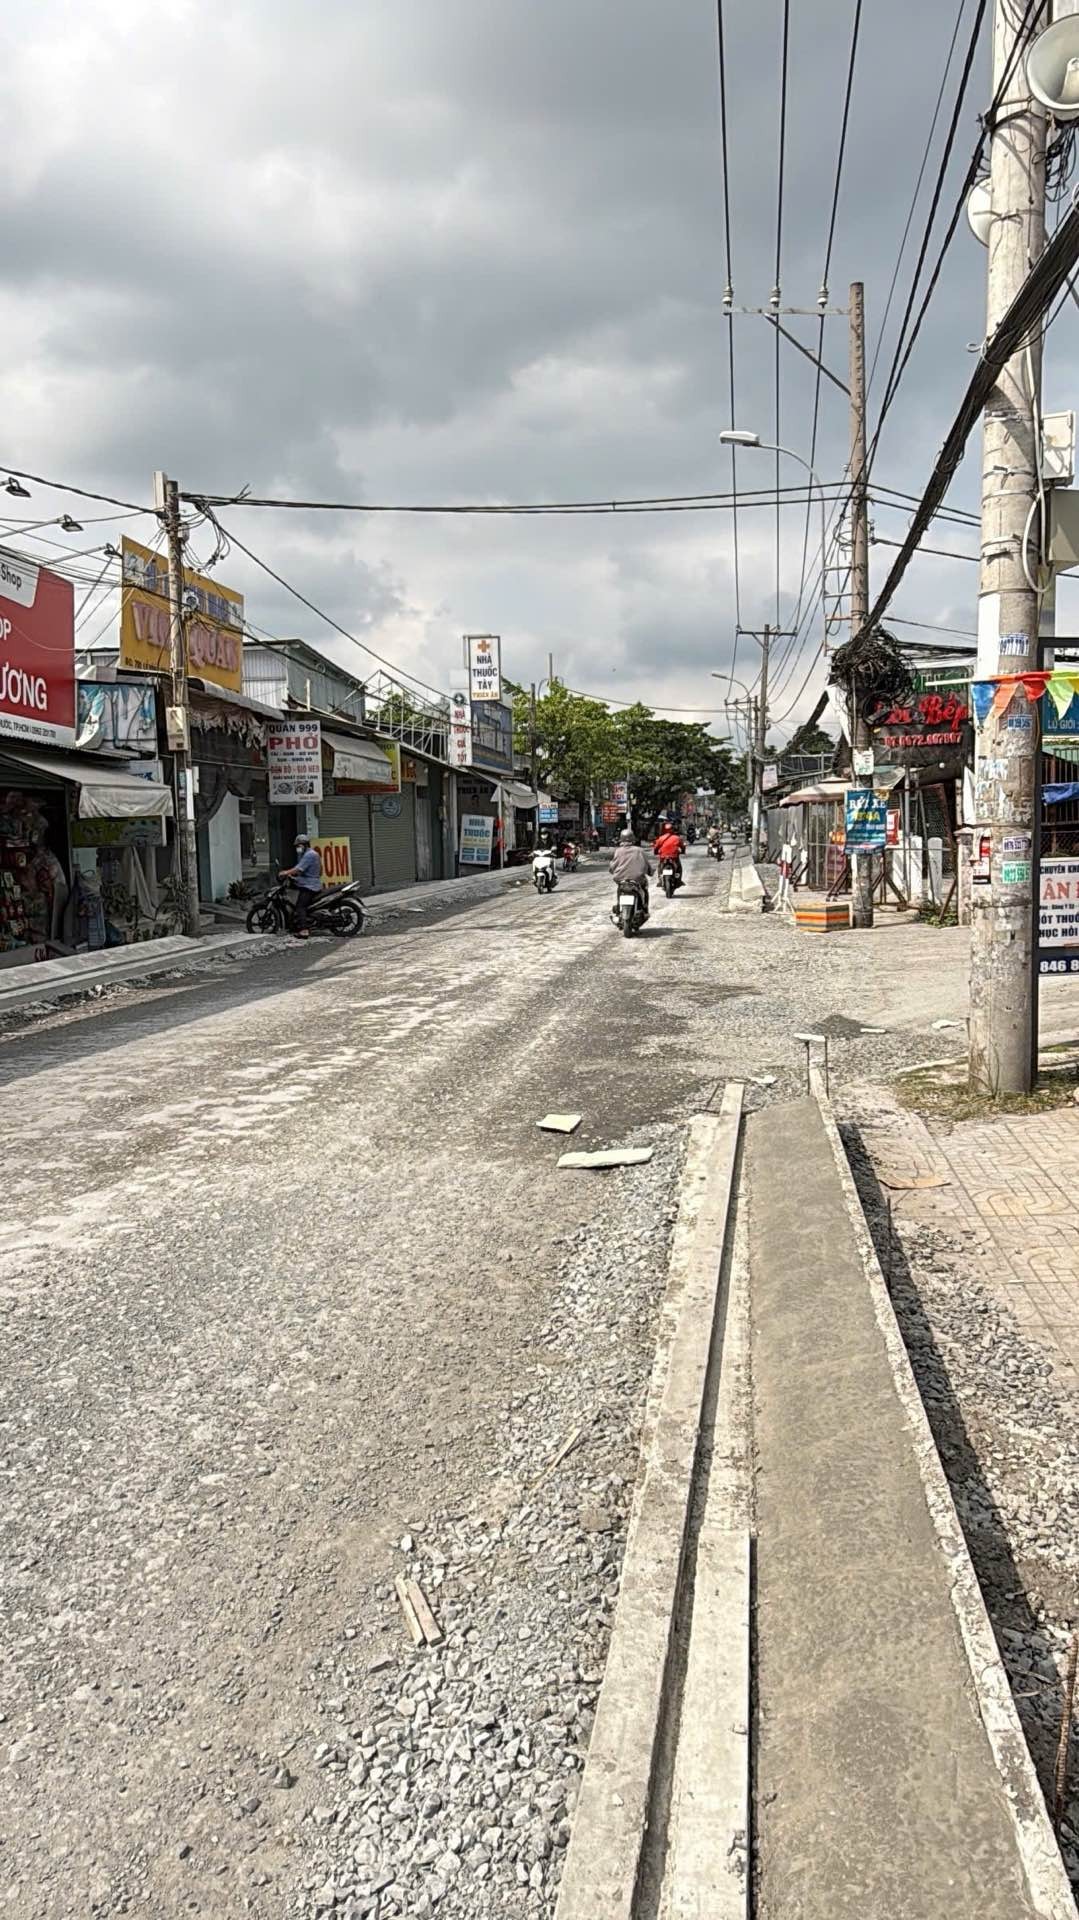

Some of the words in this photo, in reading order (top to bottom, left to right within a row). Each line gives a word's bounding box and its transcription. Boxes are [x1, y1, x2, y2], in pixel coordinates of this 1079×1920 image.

[1, 563, 22, 591] Shop
[476, 653, 492, 664] NHÀ
[472, 665, 498, 677] THUỐC
[299, 723, 318, 733] 999
[269, 732, 319, 750] PHỞ
[1039, 864, 1065, 874] CHUYÊN
[1043, 878, 1071, 900] ÂN
[1040, 961, 1067, 972] 846
